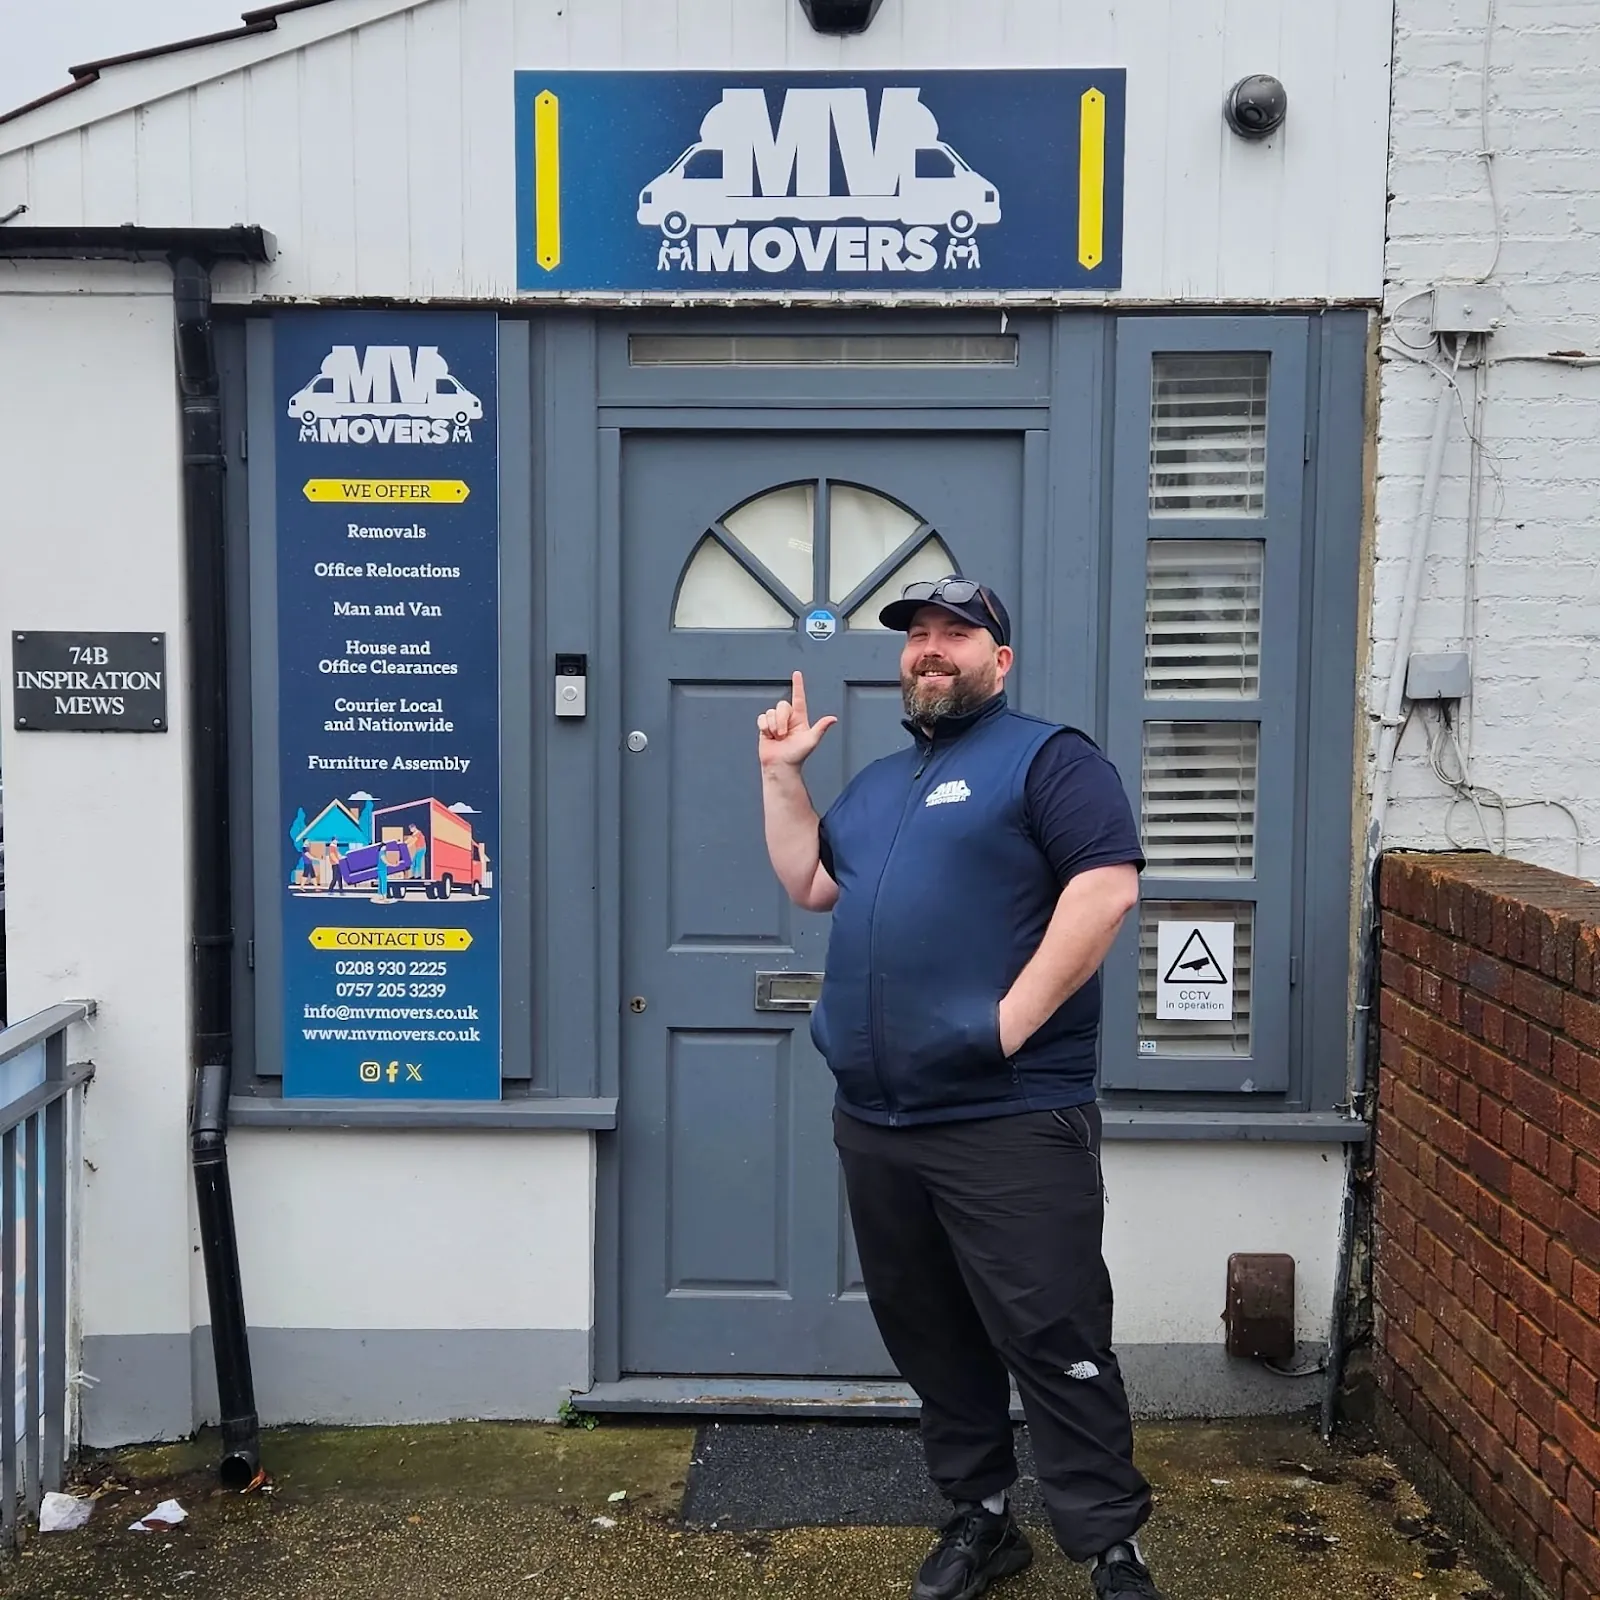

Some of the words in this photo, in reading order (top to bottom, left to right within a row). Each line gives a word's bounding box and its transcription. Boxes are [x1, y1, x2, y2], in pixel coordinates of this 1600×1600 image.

[722, 87, 921, 197] MV
[697, 227, 938, 273] MOVERS
[332, 345, 439, 404] MV
[319, 418, 450, 444] MOVERS
[342, 484, 371, 497] WE
[375, 485, 431, 498] OFFER
[347, 524, 426, 539] Removals
[314, 563, 363, 577] Office
[366, 563, 461, 578] Relocations
[333, 602, 371, 616] Man
[374, 602, 405, 616] and
[408, 602, 442, 616] Van
[345, 640, 397, 655] House
[400, 641, 431, 655] and
[69, 646, 109, 665] 74B
[318, 660, 367, 674] Office
[370, 660, 458, 675] Clearances
[16, 671, 161, 690] INSPIRATION
[54, 696, 125, 715] MEWS
[334, 698, 396, 713] Courier
[400, 698, 443, 713] Local
[324, 718, 355, 732] and
[358, 718, 454, 732] Nationwide
[308, 756, 388, 770] Furniture
[391, 756, 470, 773] Assembly
[336, 933, 418, 946] CONTACT
[424, 933, 445, 946] US
[335, 961, 374, 975] 0208
[377, 961, 406, 976] 930
[409, 961, 447, 976] 2225
[336, 983, 374, 997] 0757
[377, 983, 406, 997] 205
[409, 983, 446, 998] 3239
[1179, 991, 1211, 1000] CCTV
[304, 1004, 479, 1021] info@mvmovers.co.uk
[1178, 1001, 1224, 1011] operation
[302, 1027, 480, 1042] www.mvmovers.co.uk
